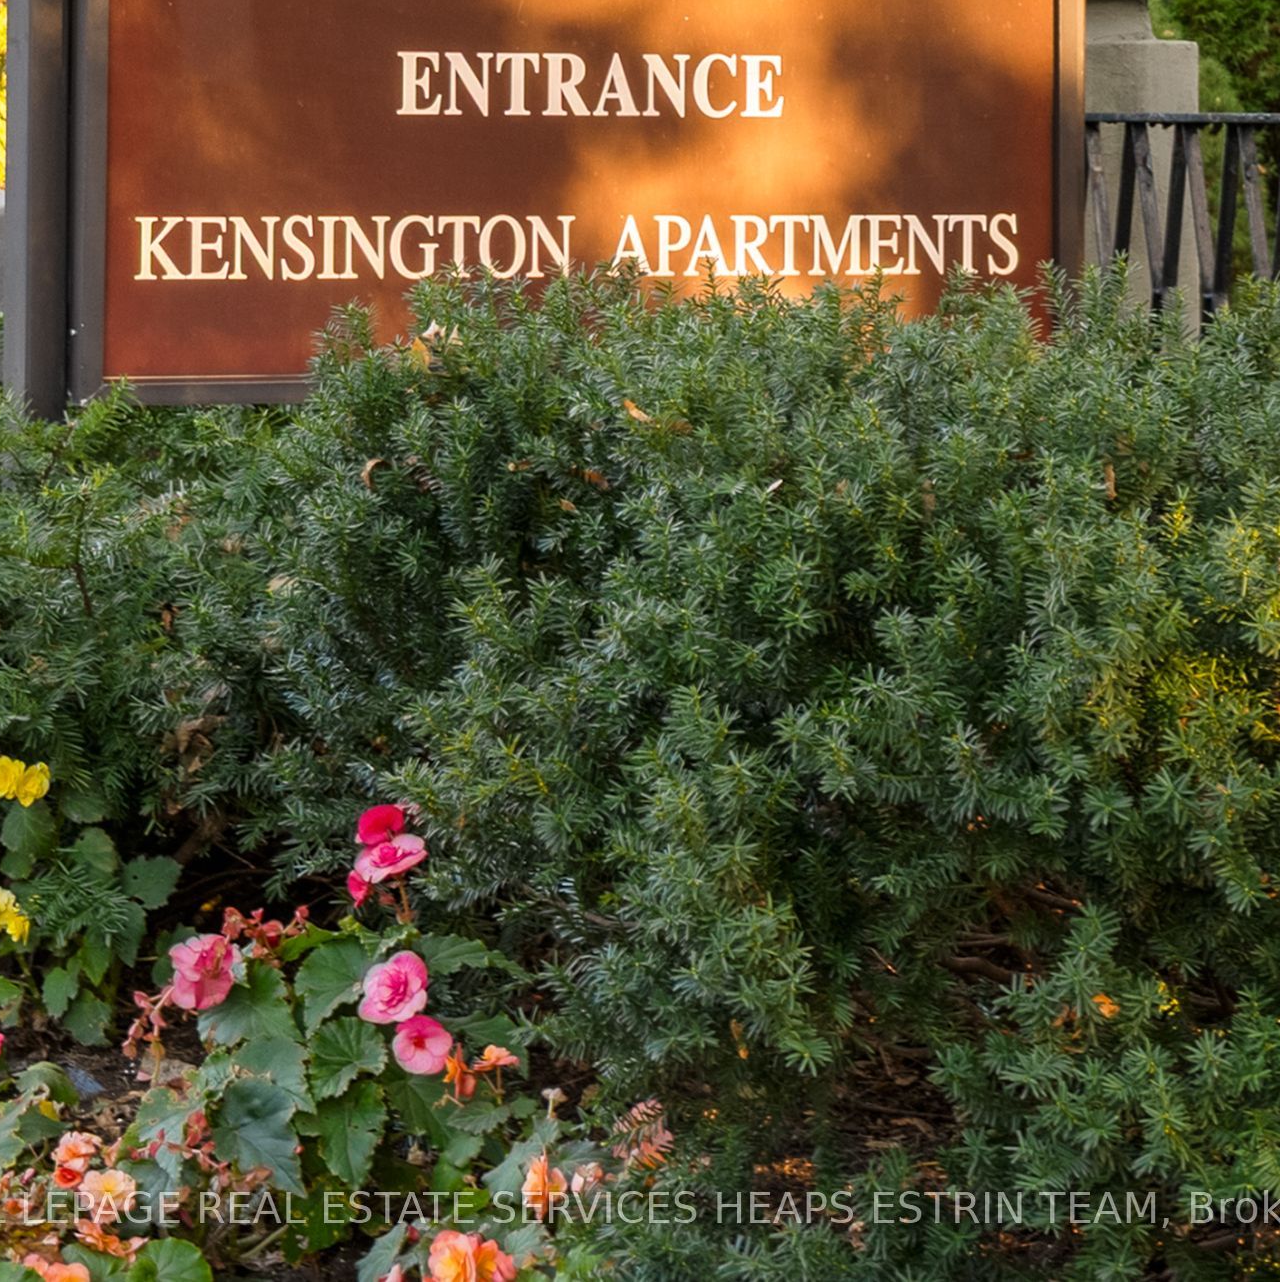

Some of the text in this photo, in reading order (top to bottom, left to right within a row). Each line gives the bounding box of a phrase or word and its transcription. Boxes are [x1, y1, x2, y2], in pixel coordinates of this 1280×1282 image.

[396, 50, 784, 118] ENTRANCE
[133, 212, 1020, 281] KENSINGTON APARTMENTS
